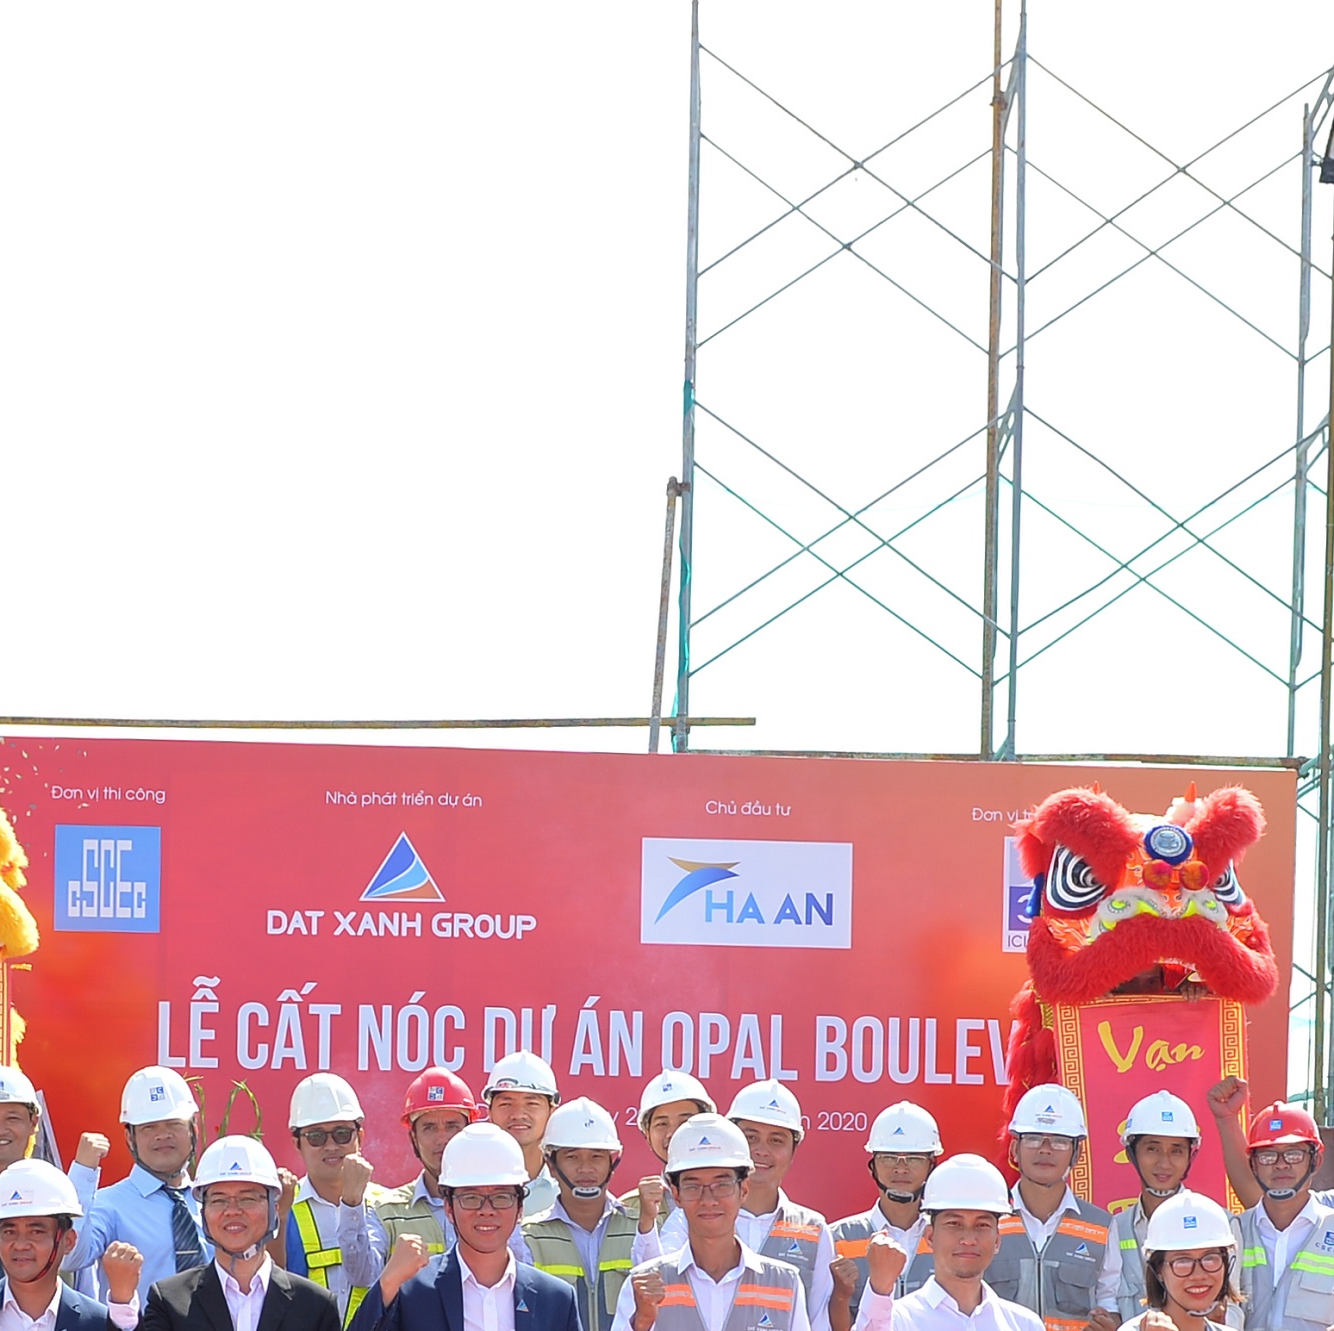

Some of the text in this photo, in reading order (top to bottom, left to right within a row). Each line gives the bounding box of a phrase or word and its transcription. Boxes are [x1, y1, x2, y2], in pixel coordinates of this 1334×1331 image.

[51, 785, 83, 799] Đơn
[103, 786, 122, 800] thi
[125, 788, 166, 804] công
[325, 790, 482, 808] Nhà phát triển dự án
[705, 800, 791, 816] Chủ đầu tư
[972, 807, 1003, 822] Đơn
[705, 890, 833, 926] HA AN
[267, 910, 537, 940] DAT XANH GROUP
[157, 975, 220, 1069] LỄ
[236, 982, 342, 1070] CẤT
[357, 991, 466, 1074] NÓC
[569, 996, 643, 1077] ÁN
[661, 1011, 798, 1081] OPAL
[815, 1015, 1018, 1086] BOULEV
[1097, 1020, 1205, 1073] Vạn
[817, 1111, 868, 1131] 2020
